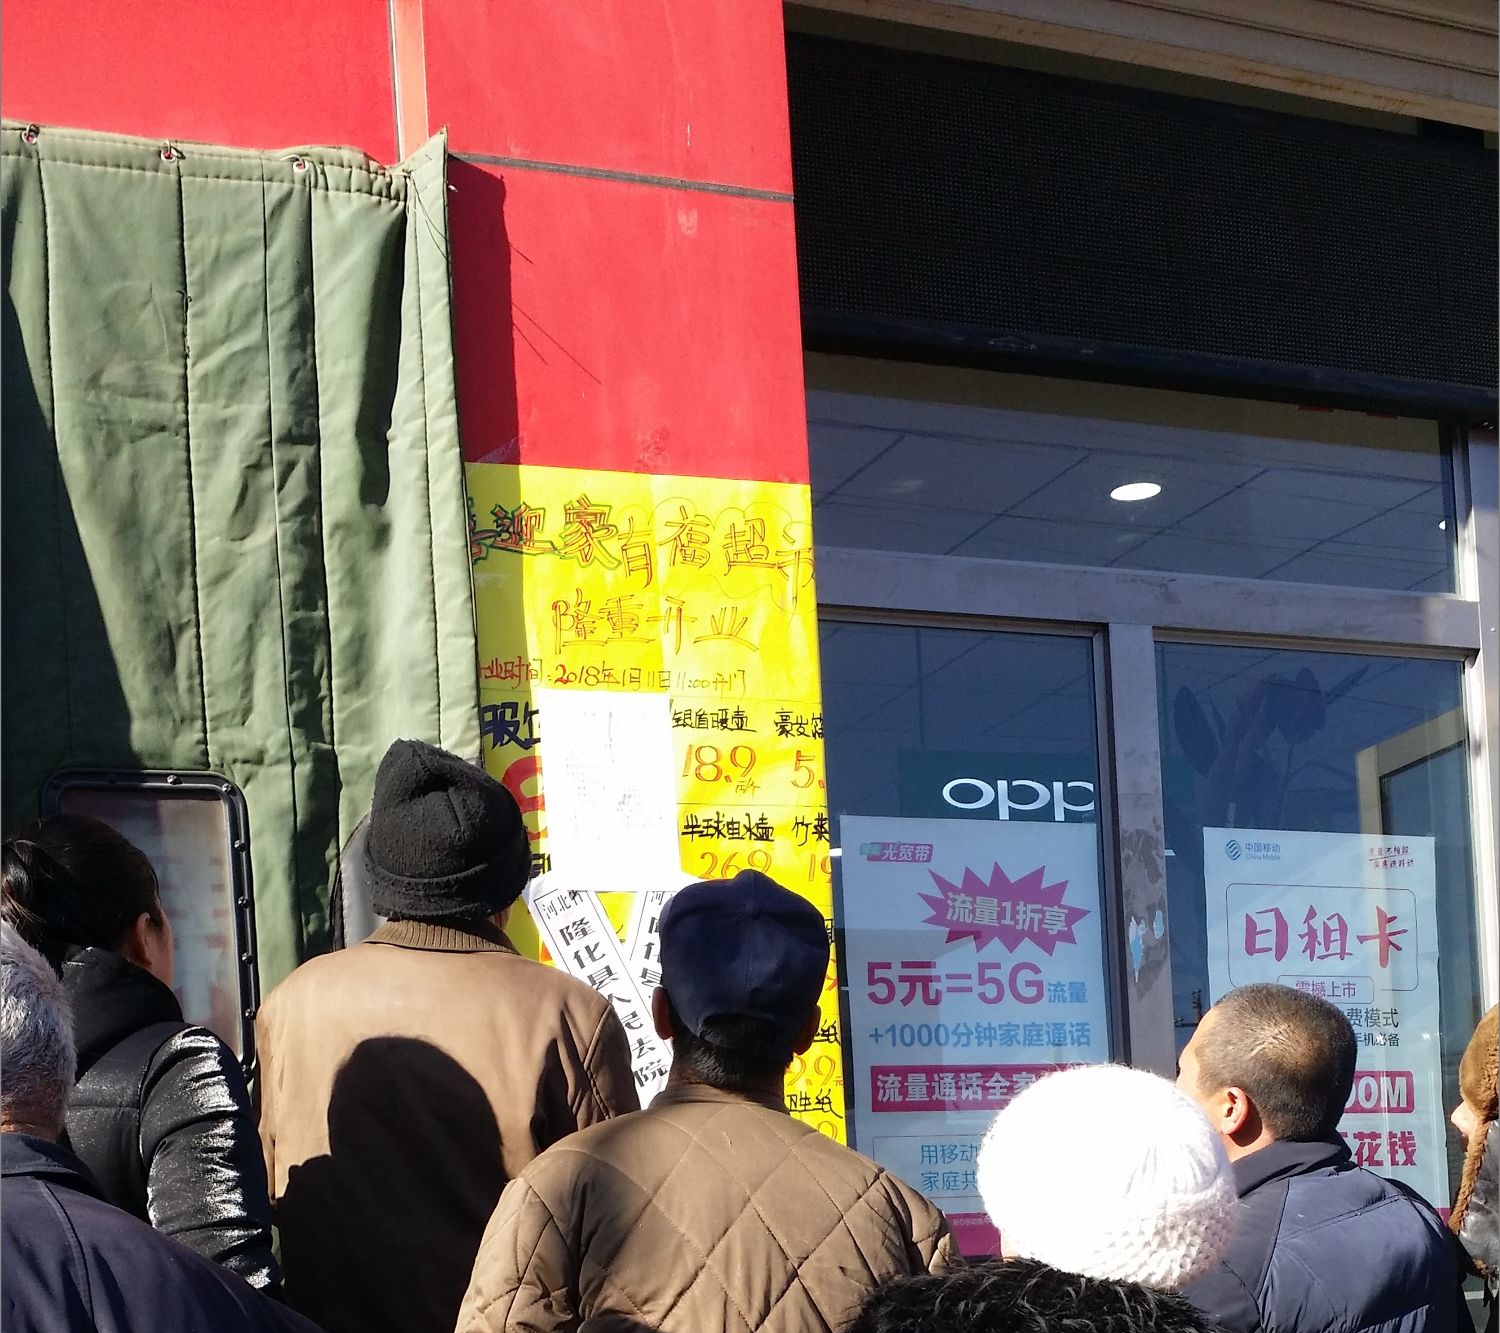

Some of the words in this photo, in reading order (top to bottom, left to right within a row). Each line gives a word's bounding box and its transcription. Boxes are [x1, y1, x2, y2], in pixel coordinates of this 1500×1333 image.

[552, 588, 760, 655] 隆重开业
[681, 811, 775, 843] 半球电水壶
[946, 891, 1069, 936] 流量1折享
[1244, 904, 1408, 969] 日租卡
[869, 1022, 1091, 1047] +1000分钟家庭通话
[1340, 1131, 1417, 1166] 花钱
